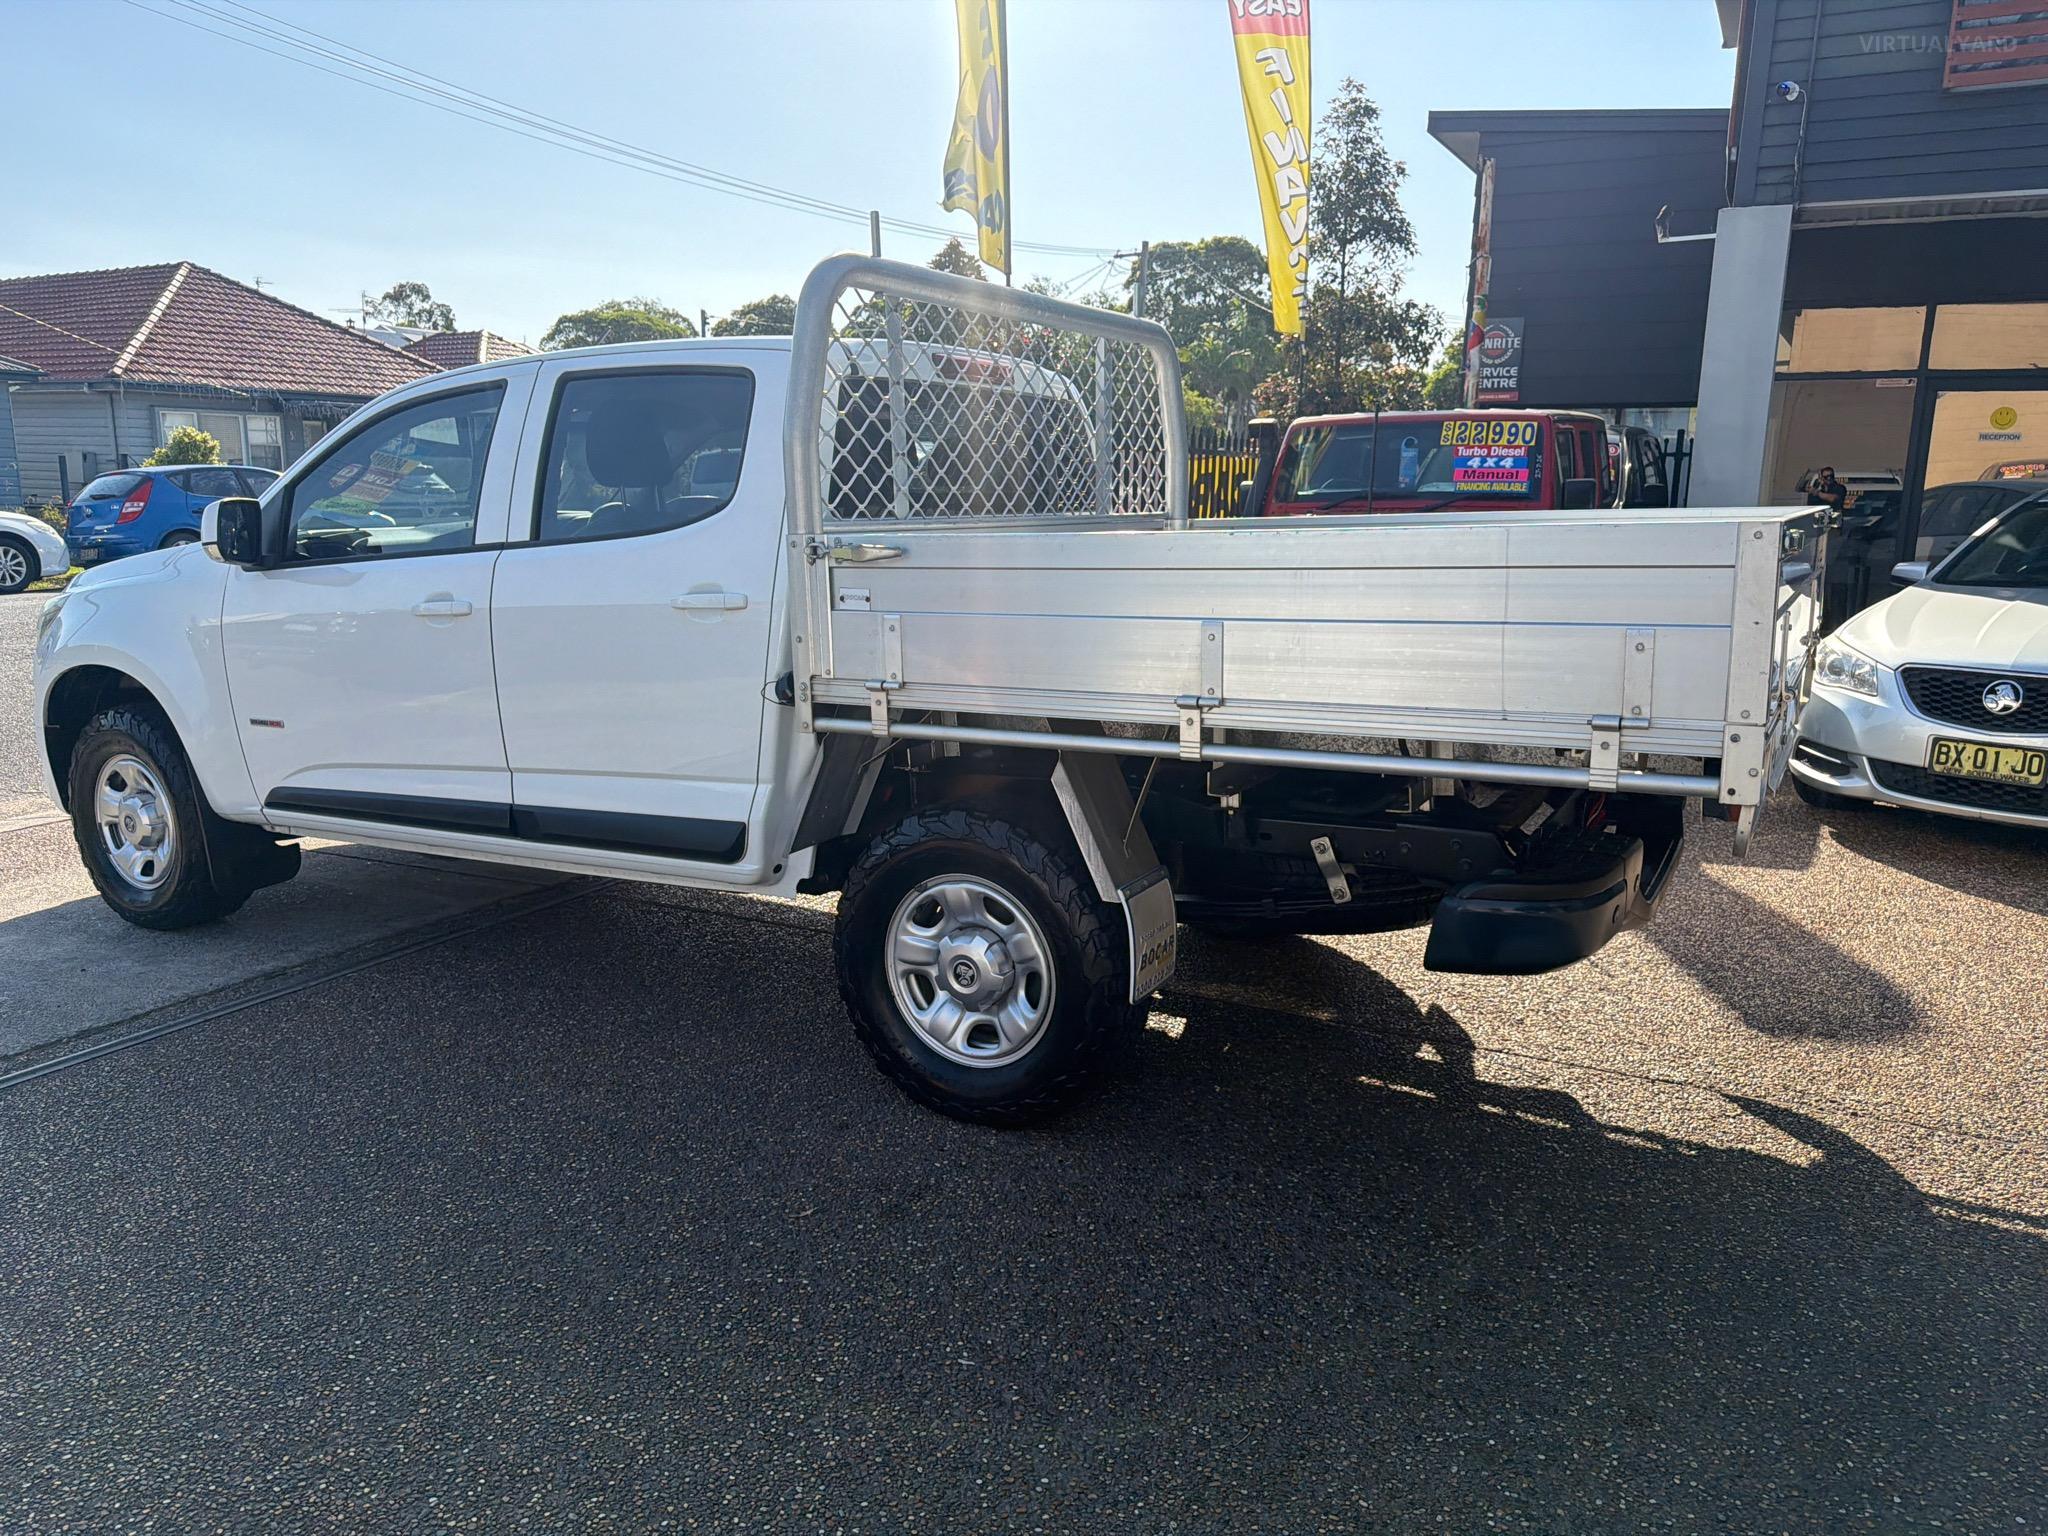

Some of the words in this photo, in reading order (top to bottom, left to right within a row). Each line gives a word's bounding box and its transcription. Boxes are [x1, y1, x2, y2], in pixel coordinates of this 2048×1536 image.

[1979, 433, 2020, 441] RECEPTION
[1457, 446, 1488, 456] Turbo
[1490, 446, 1525, 456] Diesel
[1462, 470, 1520, 479] Manual
[1456, 482, 1491, 491] FINANCING
[1491, 482, 1528, 491] AVAILABLE
[1966, 769, 1996, 778] SOUTH
[2000, 773, 2031, 784] WALES
